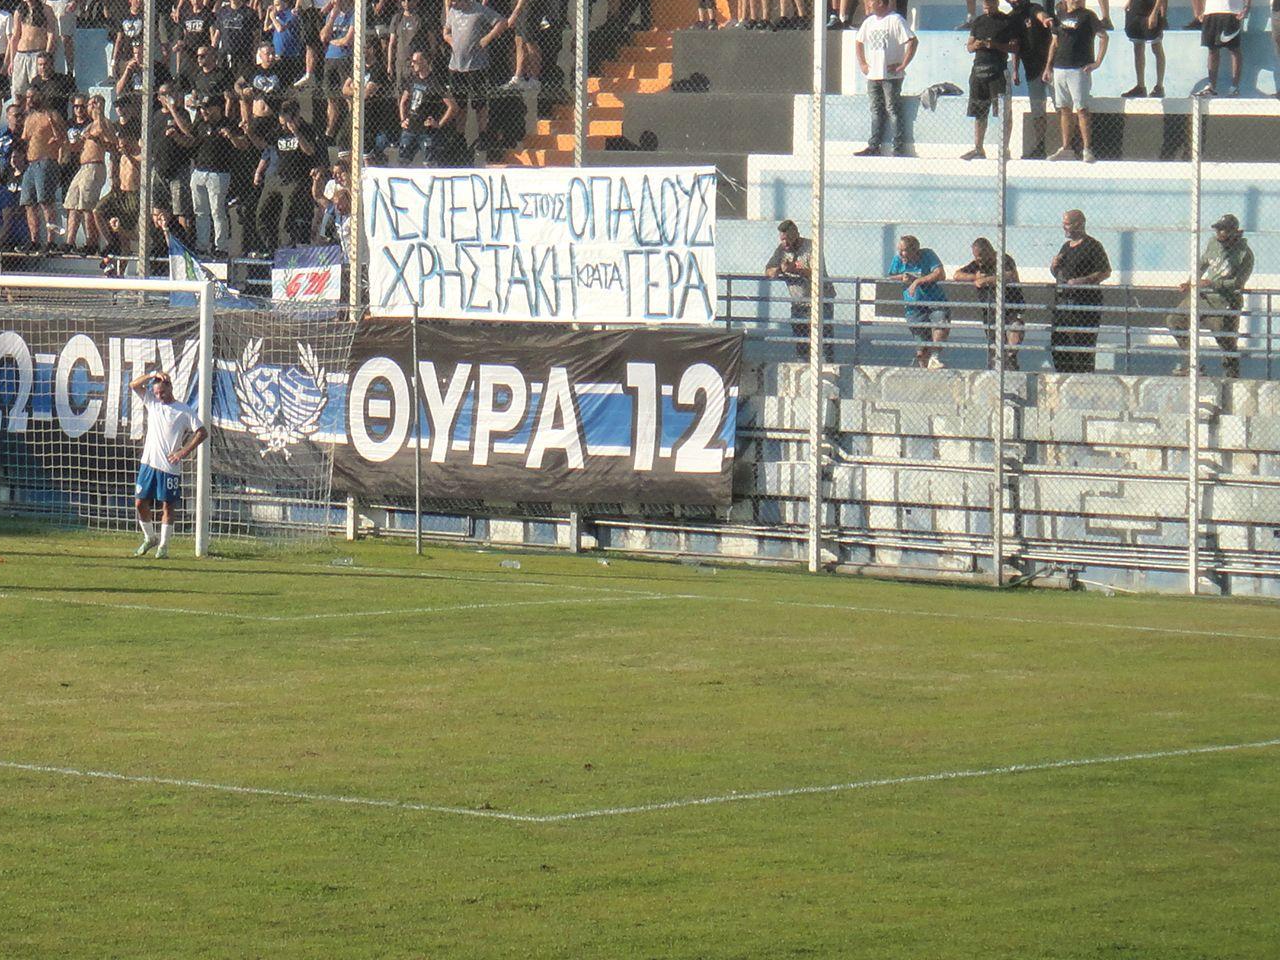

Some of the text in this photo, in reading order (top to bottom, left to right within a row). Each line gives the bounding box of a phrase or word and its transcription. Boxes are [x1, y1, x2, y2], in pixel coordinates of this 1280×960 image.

[519, 192, 567, 223] ΣΤΟΥΣ
[567, 174, 717, 247] ΟΠΑΔΟΥΣ
[381, 242, 714, 319] ΧΡΗΣΤΑΚΗ ΚΡΑΤΑ ΓΕΡΑ
[55, 333, 200, 440] CITY
[349, 357, 585, 469] ΘΥΡΑ
[626, 362, 726, 473] 12
[166, 477, 179, 490] 63
